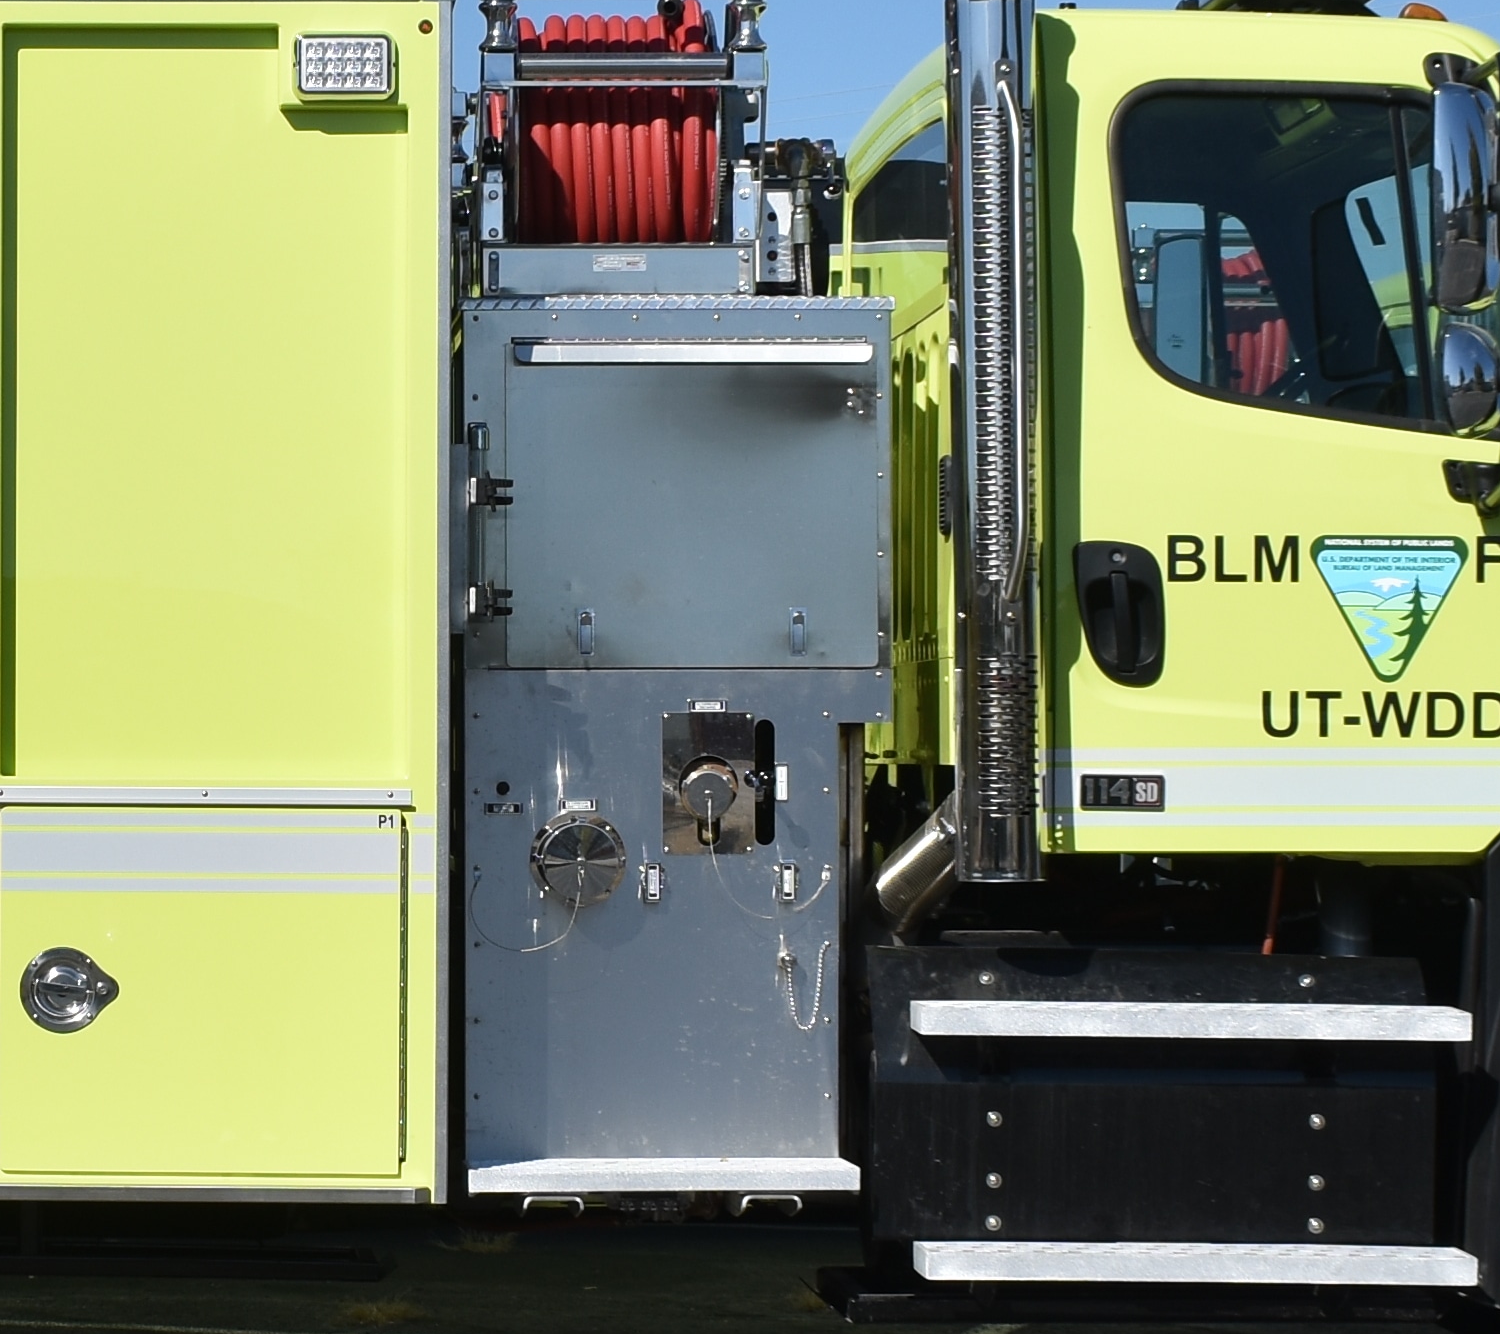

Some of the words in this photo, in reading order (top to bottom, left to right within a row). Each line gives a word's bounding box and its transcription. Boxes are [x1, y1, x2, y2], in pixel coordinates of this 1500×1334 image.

[1167, 534, 1300, 583] BLM
[1404, 556, 1418, 564] THE
[1420, 556, 1456, 564] INTERIOR
[1084, 777, 1131, 805] 114
[1135, 781, 1159, 803] SD
[378, 814, 394, 829] P1
